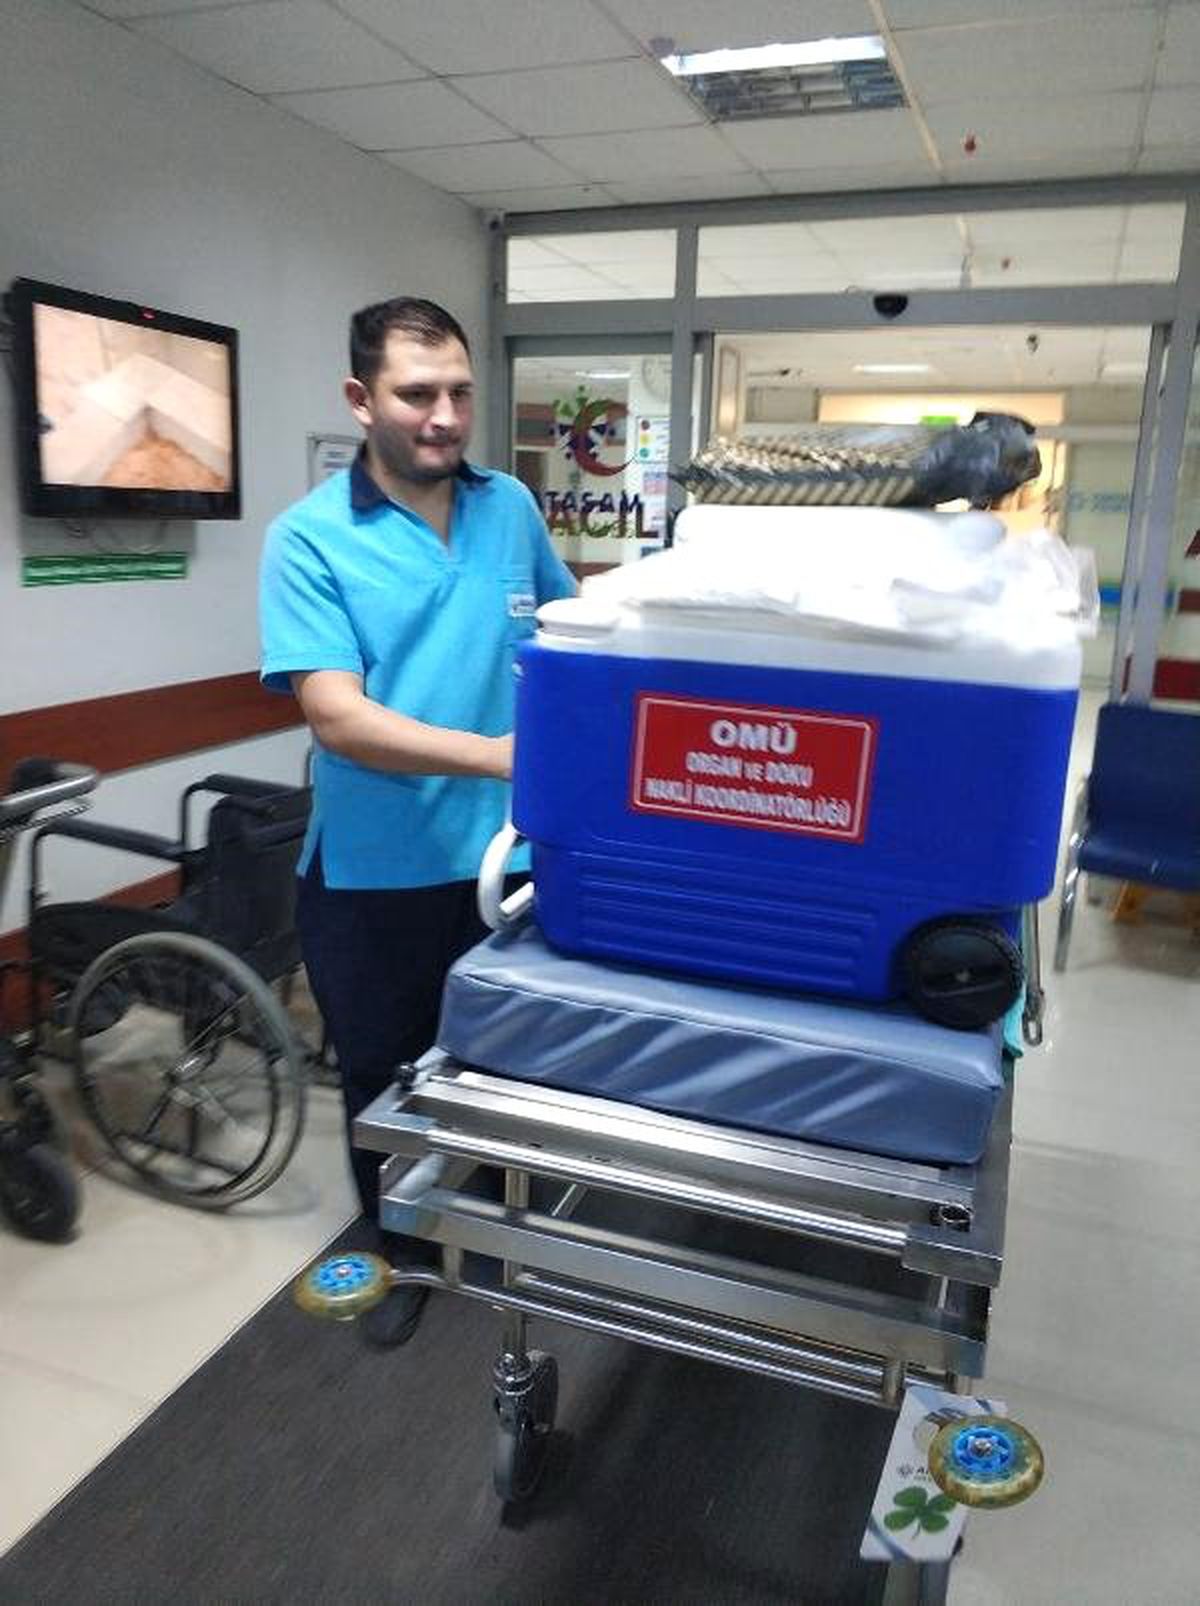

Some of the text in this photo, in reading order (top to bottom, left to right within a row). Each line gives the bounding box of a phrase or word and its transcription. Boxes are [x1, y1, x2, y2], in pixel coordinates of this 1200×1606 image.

[536, 490, 642, 513] TASAM
[710, 719, 797, 754] OMÜ
[686, 751, 742, 779] ORGAN
